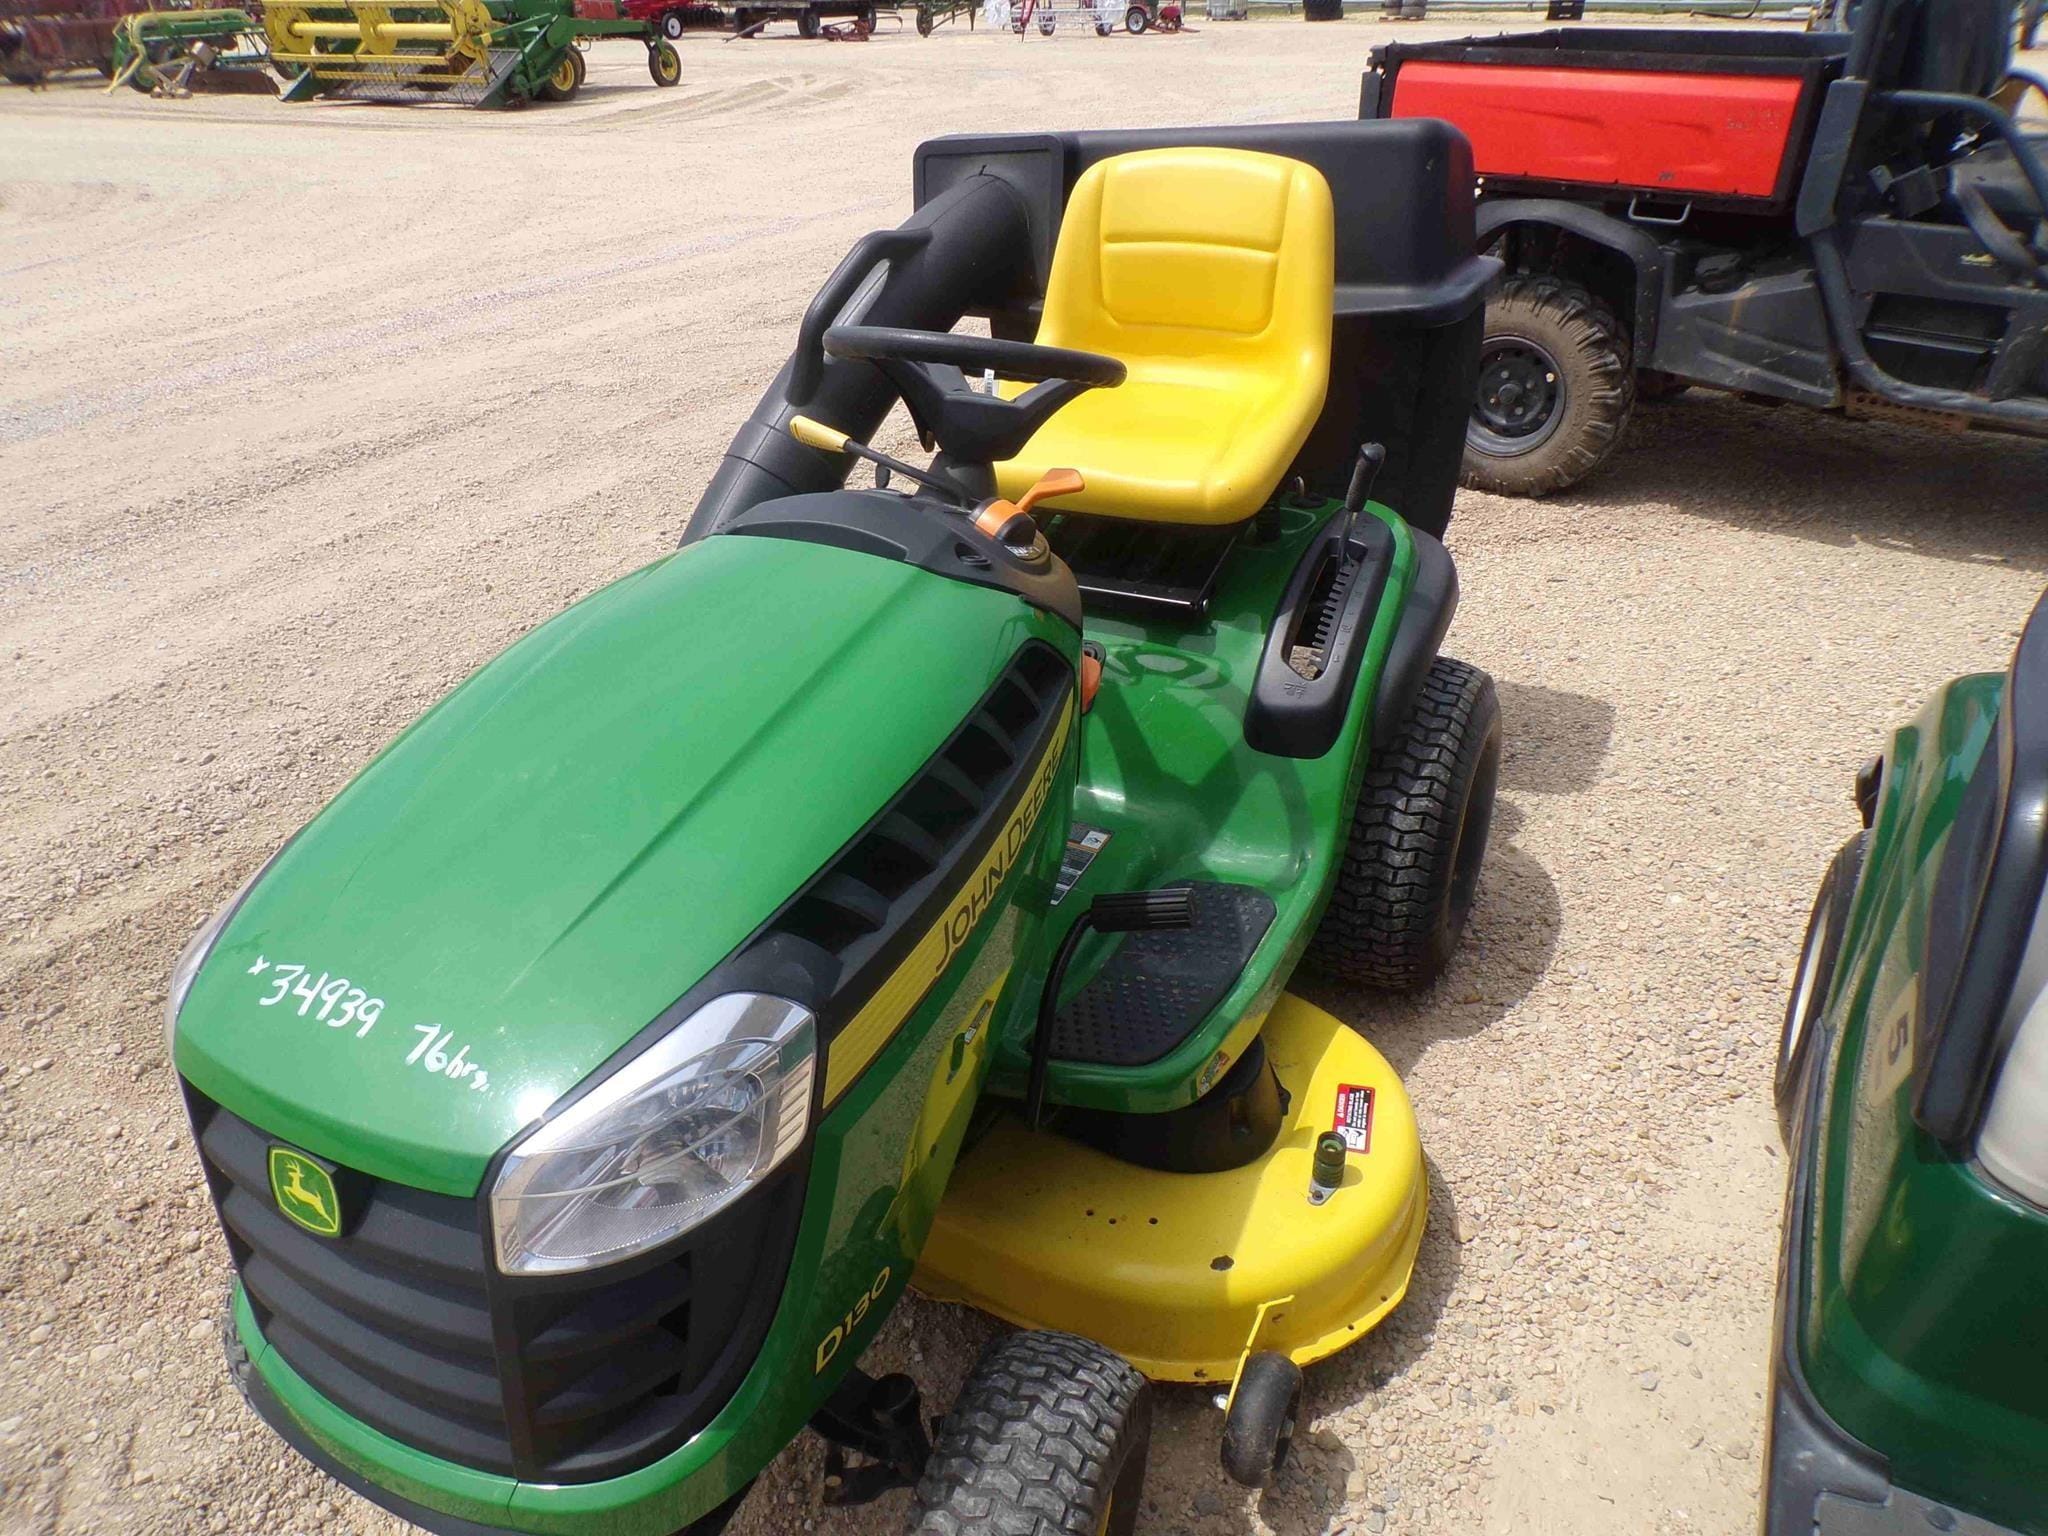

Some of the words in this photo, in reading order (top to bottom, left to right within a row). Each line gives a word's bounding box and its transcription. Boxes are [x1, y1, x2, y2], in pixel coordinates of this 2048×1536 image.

[936, 851, 1004, 972] JOHN
[1007, 739, 1060, 860] DEERE
[815, 1266, 890, 1375] D130
